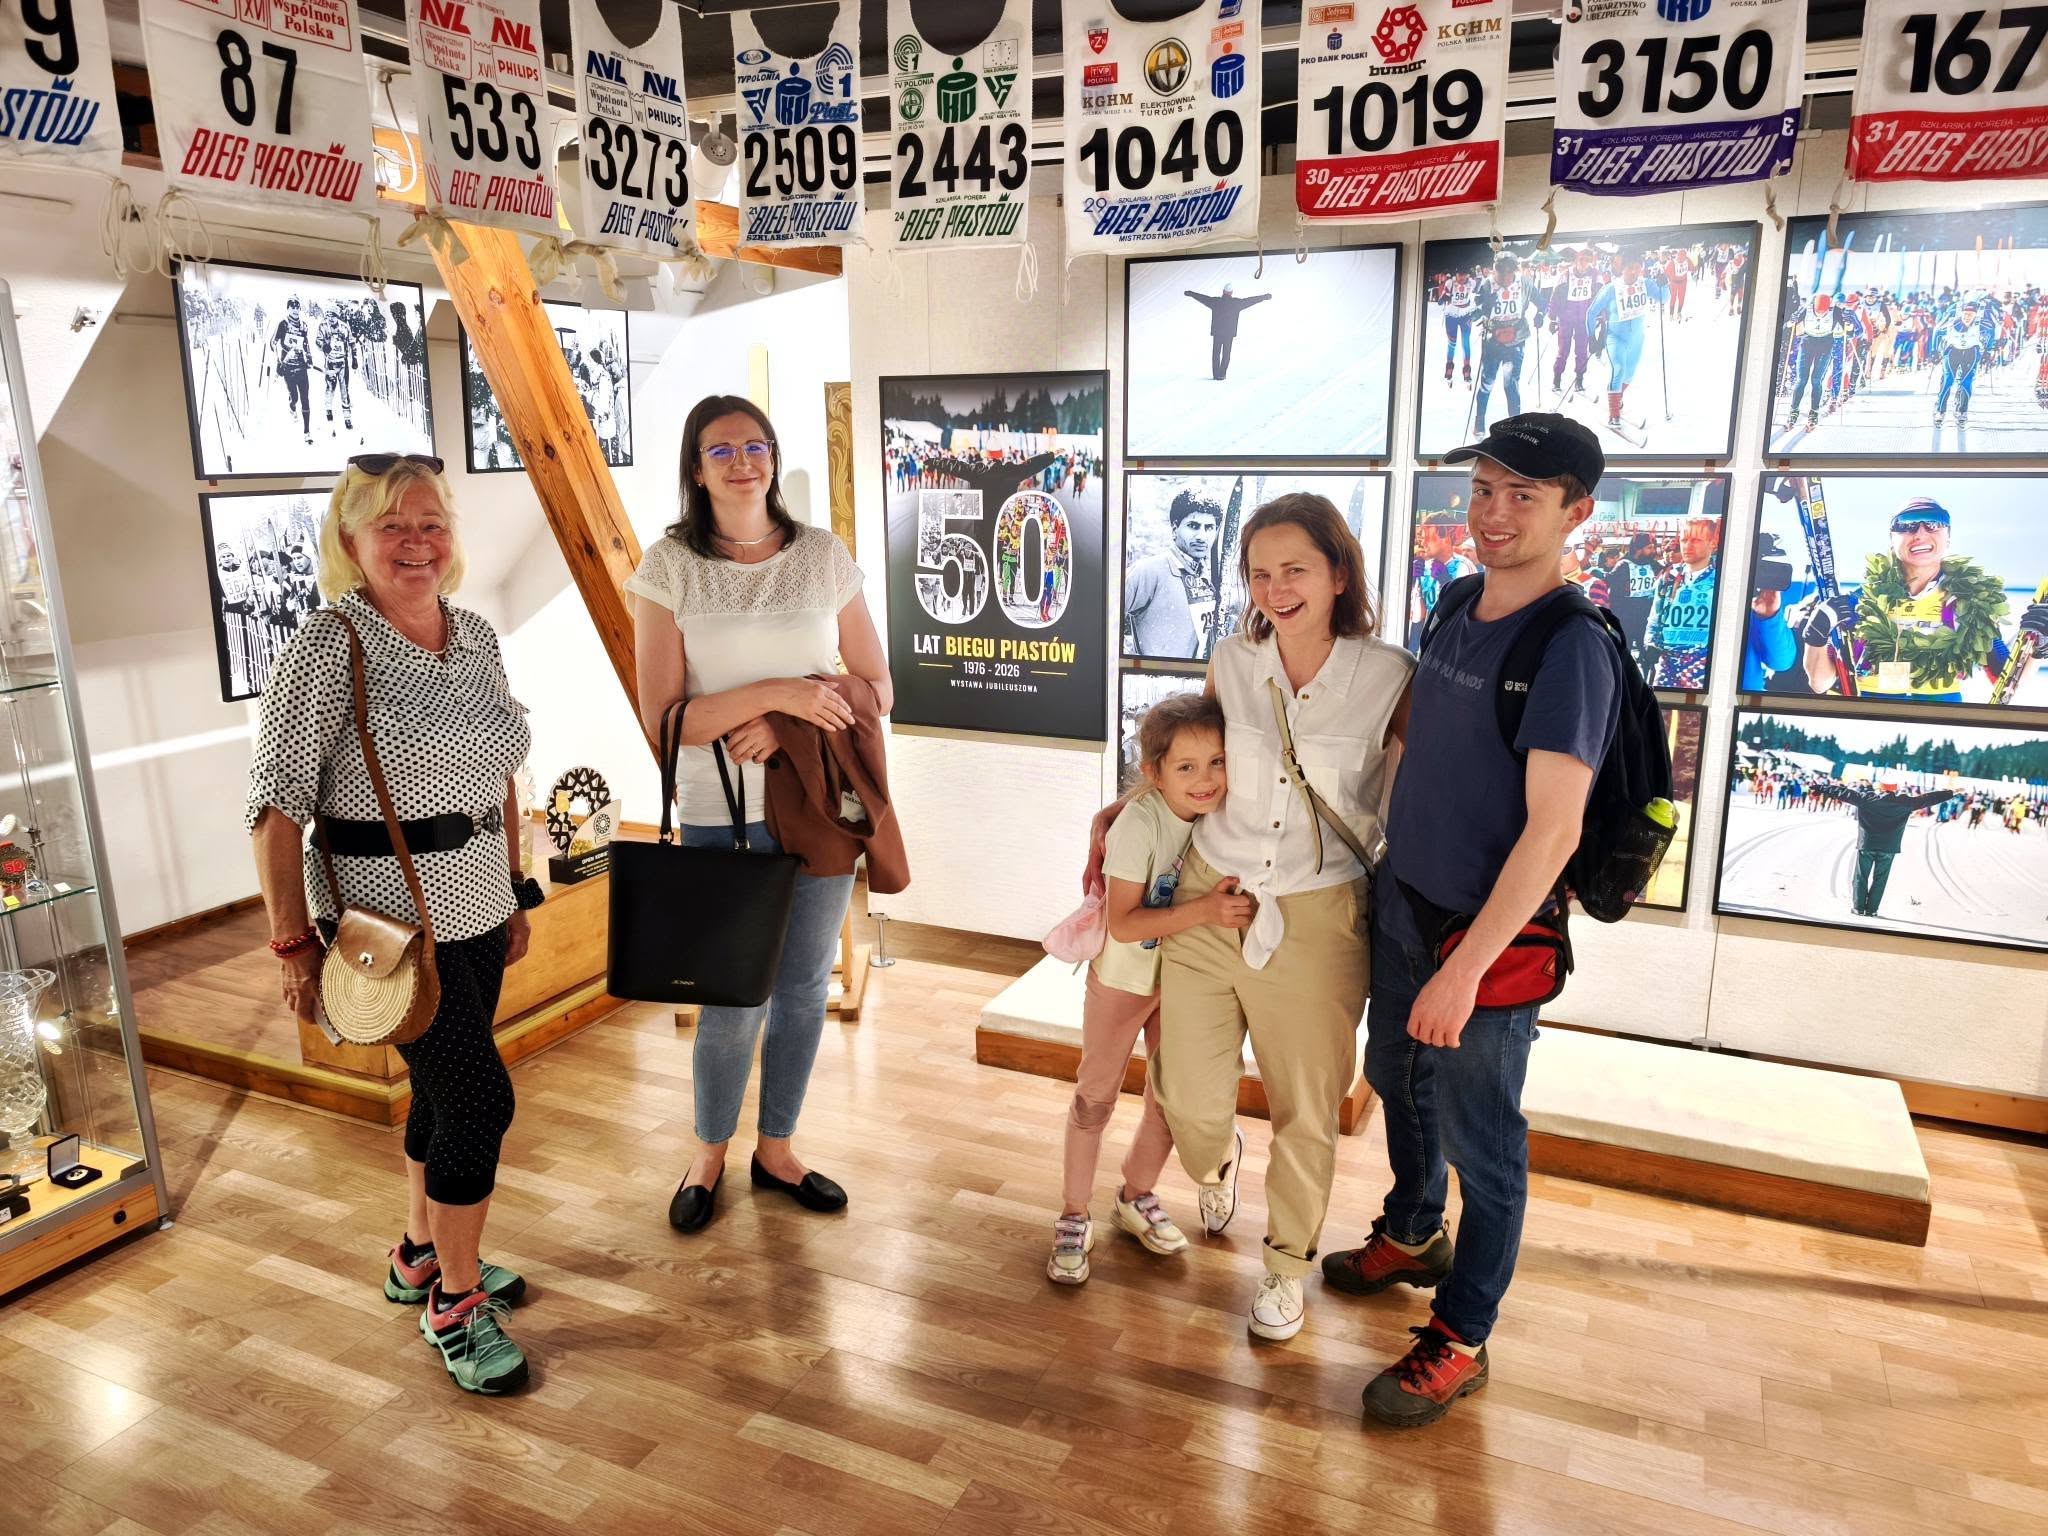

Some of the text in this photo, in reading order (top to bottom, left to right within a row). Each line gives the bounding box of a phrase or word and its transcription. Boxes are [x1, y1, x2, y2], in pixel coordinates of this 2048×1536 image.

[1587, 1, 1647, 13] TOWARZYSTWO
[283, 15, 335, 40] Polska
[1437, 17, 1502, 40] KGHM
[1301, 52, 1368, 65] PKO BANK POLSKI
[1902, 6, 2048, 96] 167
[434, 54, 461, 72] Polska
[497, 59, 539, 81] PHILIPS
[1092, 66, 1111, 77] TVP
[1369, 60, 1427, 77] bumar
[1578, 29, 1773, 118] 3150
[216, 29, 298, 136] 87
[904, 79, 934, 88] POLONIA
[1087, 76, 1115, 84] POLONIA
[590, 88, 628, 108] Wspólnota
[1082, 92, 1134, 109] KGHM
[1140, 95, 1196, 110] ELEKTROWNIA
[443, 72, 541, 171] 533
[597, 102, 622, 118] Polska
[647, 107, 682, 128] PHILIPS
[1141, 106, 1175, 117] TURÓW
[1314, 69, 1483, 155] 1019
[1865, 119, 1900, 144] 31
[1920, 120, 1971, 130] SZKLARSKA
[1557, 136, 1584, 156] 31
[1601, 130, 1739, 145] SZKLARSKA PORĘBA JAKUSZYCE
[181, 128, 249, 182] BIEG
[588, 116, 689, 207] 3273
[744, 124, 857, 197] 2509
[897, 122, 1028, 198] 2443
[1080, 109, 1244, 192] 1040
[1874, 131, 1967, 174] BIEG
[1305, 168, 1330, 185] 30
[1565, 145, 1643, 185] BIEG
[450, 169, 480, 208] BIEG
[1313, 174, 1380, 209] BIEG
[1083, 198, 1107, 213] 29
[600, 201, 636, 237] BIEG
[748, 203, 788, 235] BIEG
[895, 211, 905, 223] 24
[900, 207, 942, 242] BIEG
[1093, 203, 1151, 236] BIEG
[1118, 225, 1213, 242] MISTRZOSTWA POLSKI PZN
[1620, 292, 1647, 311] 1490
[914, 489, 1073, 629] 50
[1663, 605, 1709, 629] 2022
[913, 633, 1076, 664] LAT BIEGU PIASTÓW
[963, 661, 986, 675] 1976
[994, 664, 1020, 678] 2026
[950, 679, 1038, 693] WYSTAWA JUBILEUSZOWA
